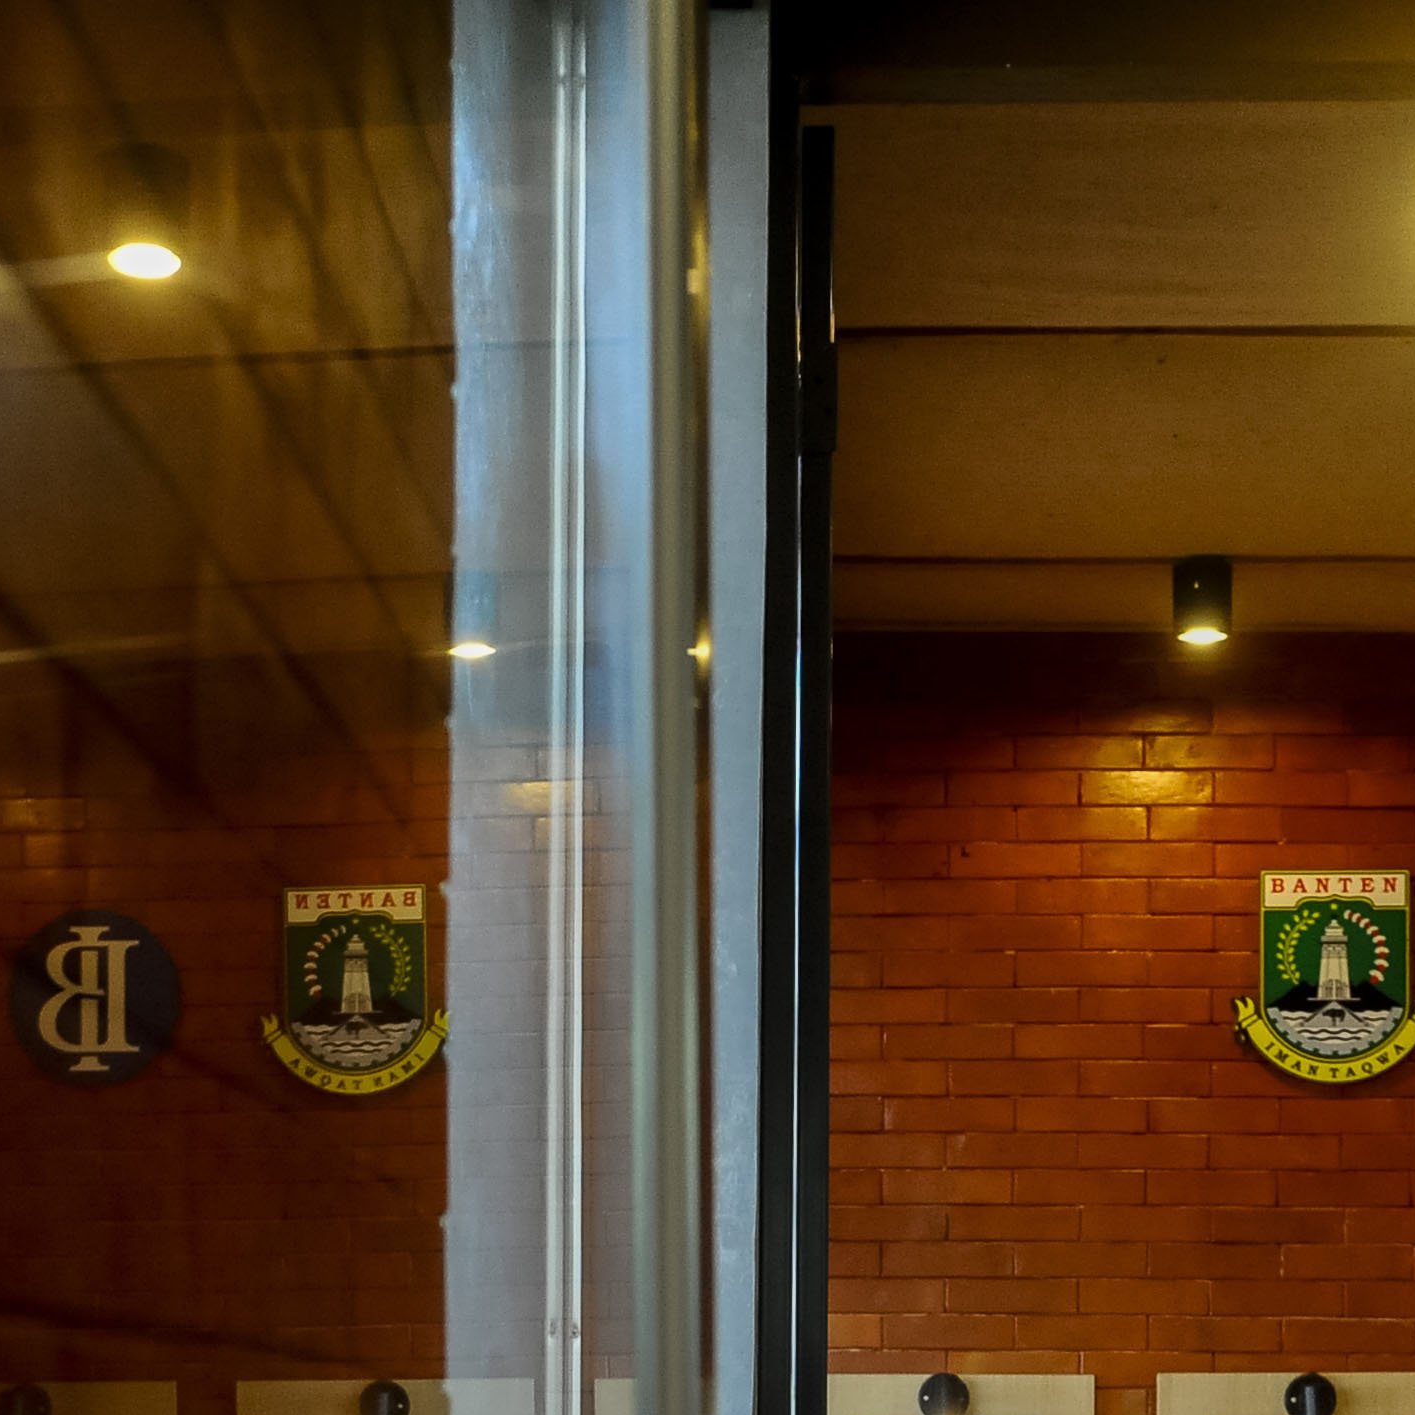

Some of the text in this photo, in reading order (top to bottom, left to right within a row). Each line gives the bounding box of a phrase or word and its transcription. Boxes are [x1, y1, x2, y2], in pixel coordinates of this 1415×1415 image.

[1270, 877, 1400, 895] BANTEN
[1264, 1042, 1409, 1080] IMAN TAQWA
